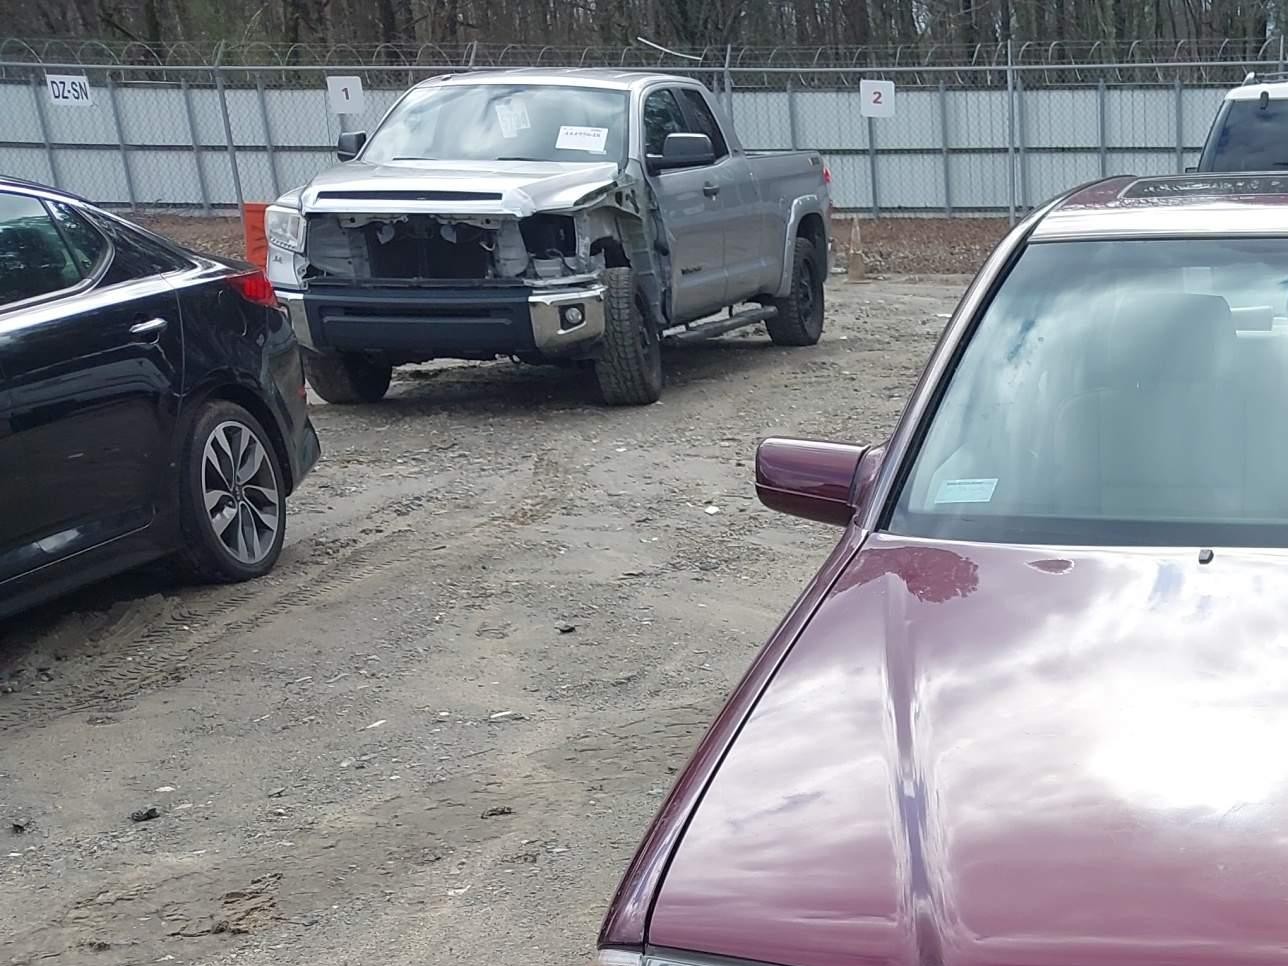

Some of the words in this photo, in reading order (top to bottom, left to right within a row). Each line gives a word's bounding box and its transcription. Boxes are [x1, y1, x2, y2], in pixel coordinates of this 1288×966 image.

[50, 80, 89, 101] DZ-SN
[341, 87, 350, 101] 1
[872, 91, 882, 105] 2
